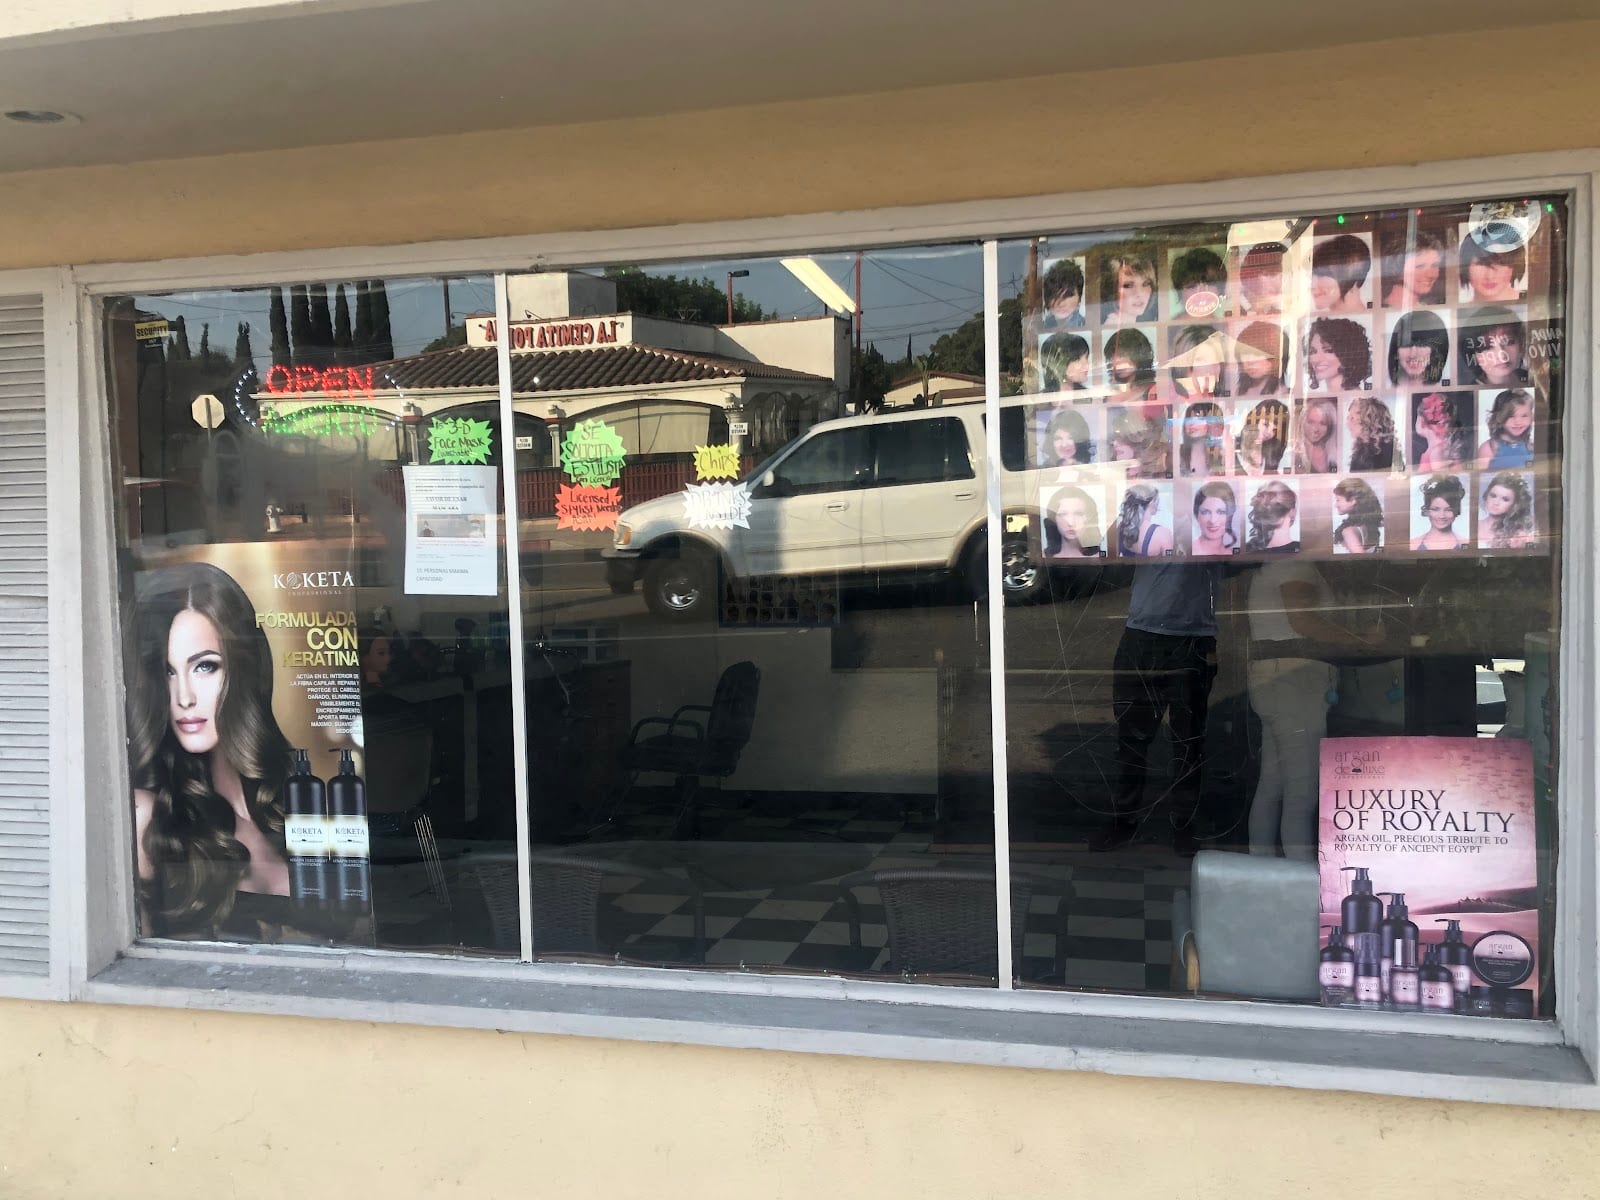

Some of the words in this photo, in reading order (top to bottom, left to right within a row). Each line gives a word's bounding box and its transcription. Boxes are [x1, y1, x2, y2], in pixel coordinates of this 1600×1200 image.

[266, 364, 374, 399] OPEN
[581, 424, 602, 440] SE
[306, 627, 358, 650] CON
[283, 650, 360, 667] KERATINA
[1334, 789, 1446, 810] LUXURY
[1333, 810, 1370, 831] OF
[1382, 810, 1515, 833] ROYALTY
[1334, 834, 1369, 843] ARGAN
[1394, 835, 1444, 844] PRECIOUS
[1446, 836, 1490, 845] TRIBUTE
[1494, 837, 1508, 845] TO
[1334, 843, 1382, 852] ROYALTY
[1384, 844, 1398, 852] OF
[1400, 844, 1446, 853] ANCIENT
[1448, 845, 1482, 854] EGYPT
